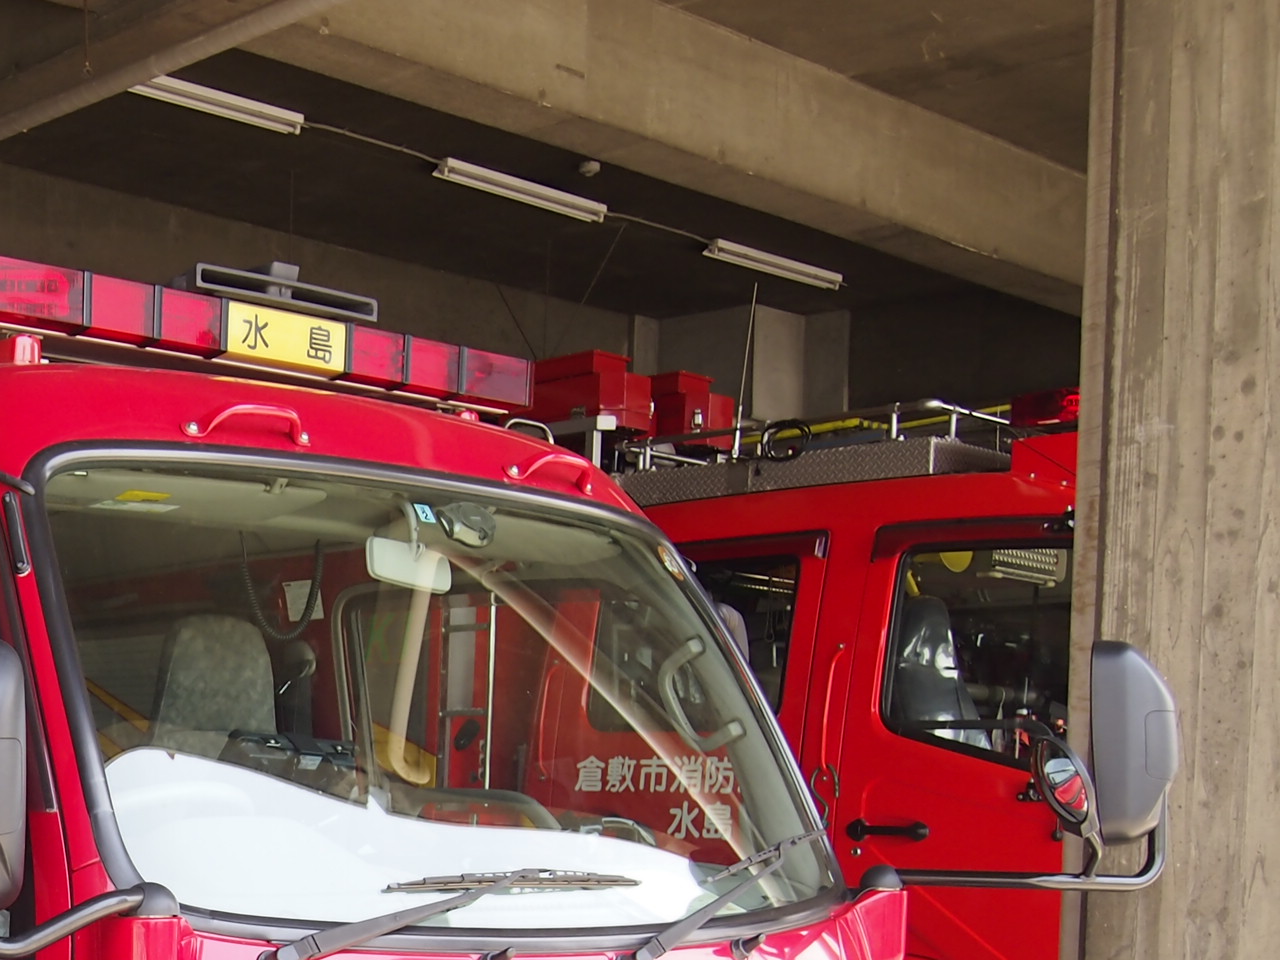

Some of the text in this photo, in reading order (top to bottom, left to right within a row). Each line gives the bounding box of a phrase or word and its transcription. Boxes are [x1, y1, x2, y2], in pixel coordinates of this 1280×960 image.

[574, 755, 741, 794] 倉敷市消防
[667, 801, 733, 841] 水島
